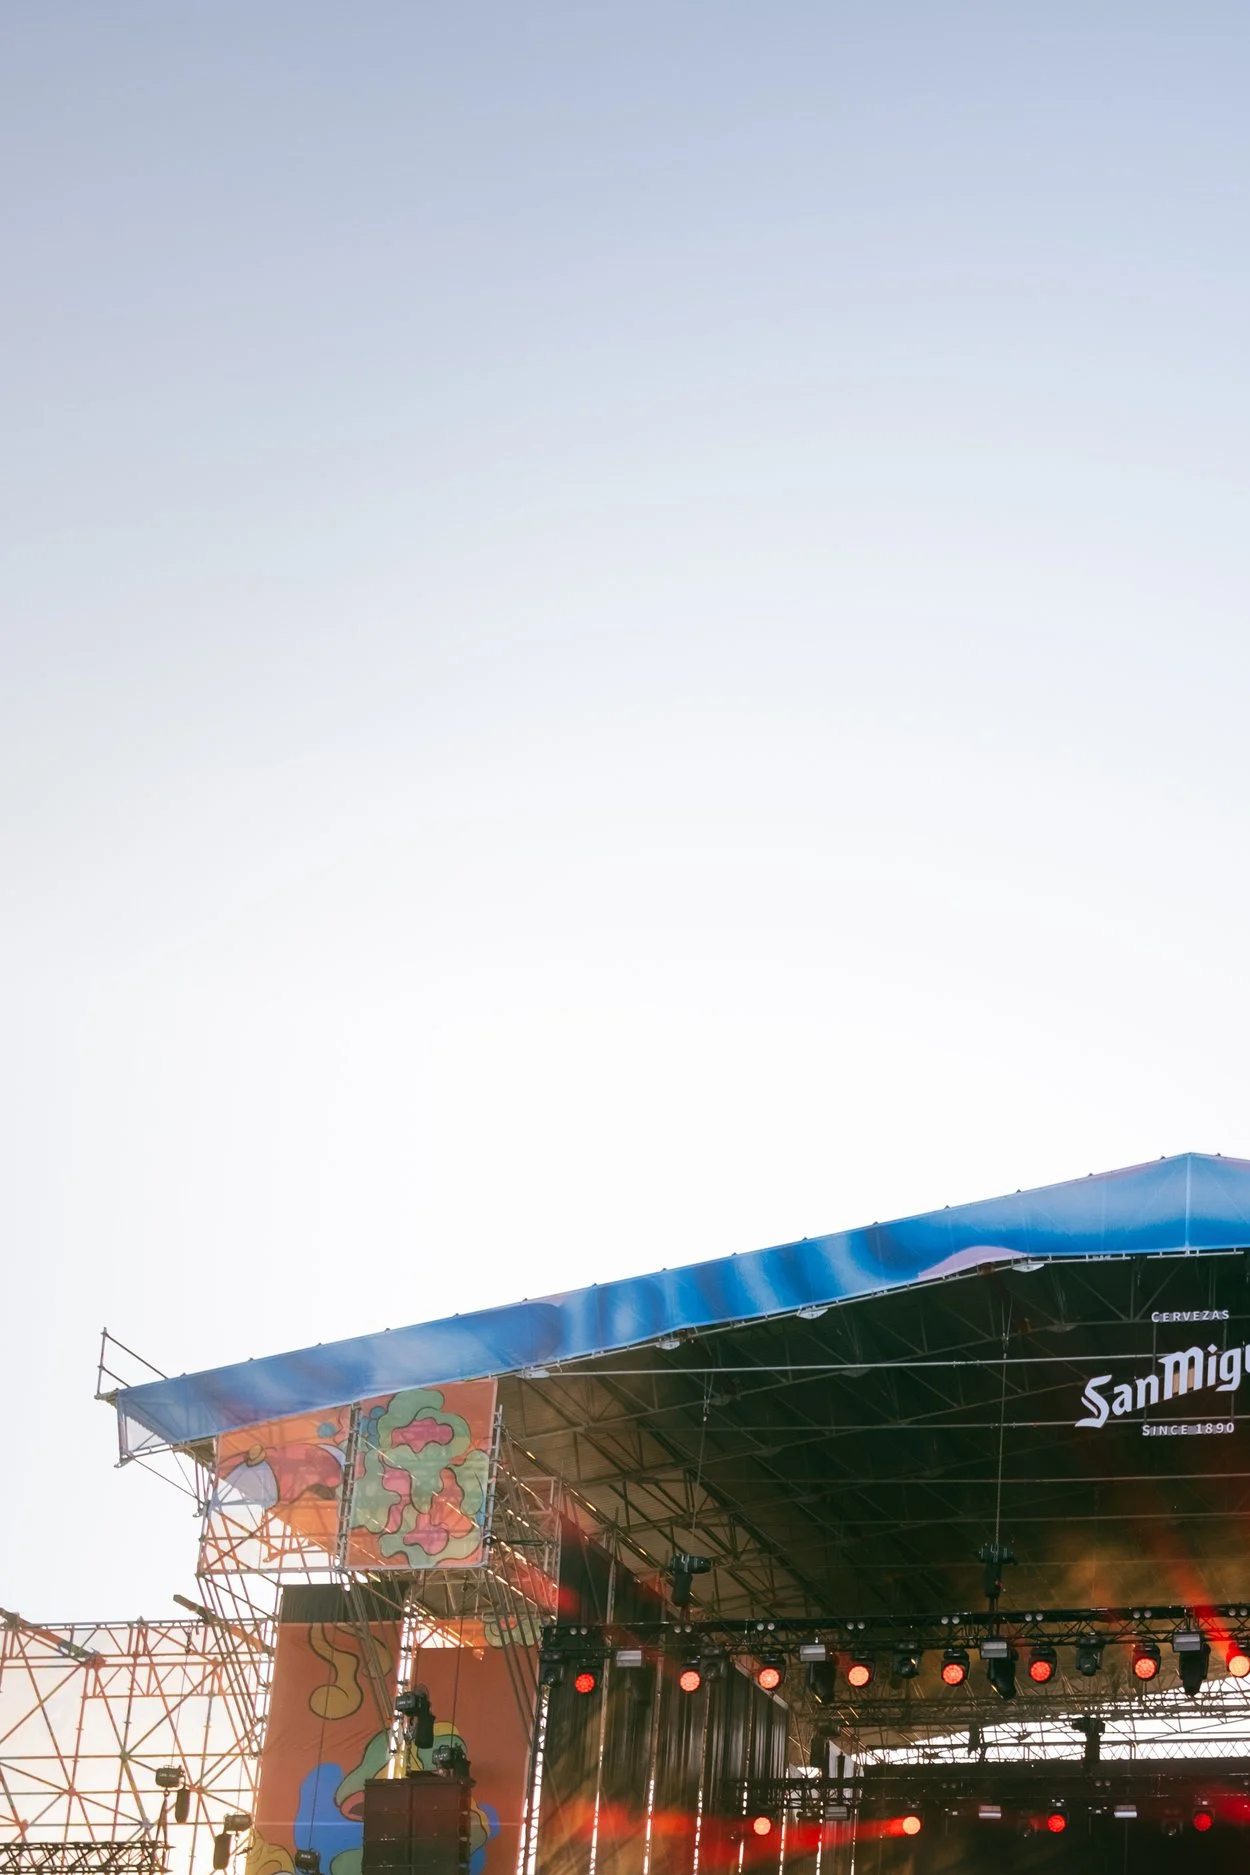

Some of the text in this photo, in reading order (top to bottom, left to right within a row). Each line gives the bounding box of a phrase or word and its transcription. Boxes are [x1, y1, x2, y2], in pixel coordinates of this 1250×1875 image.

[1151, 1309, 1230, 1323] CERVEZAS
[1142, 1422, 1235, 1436] SINCE 1890
